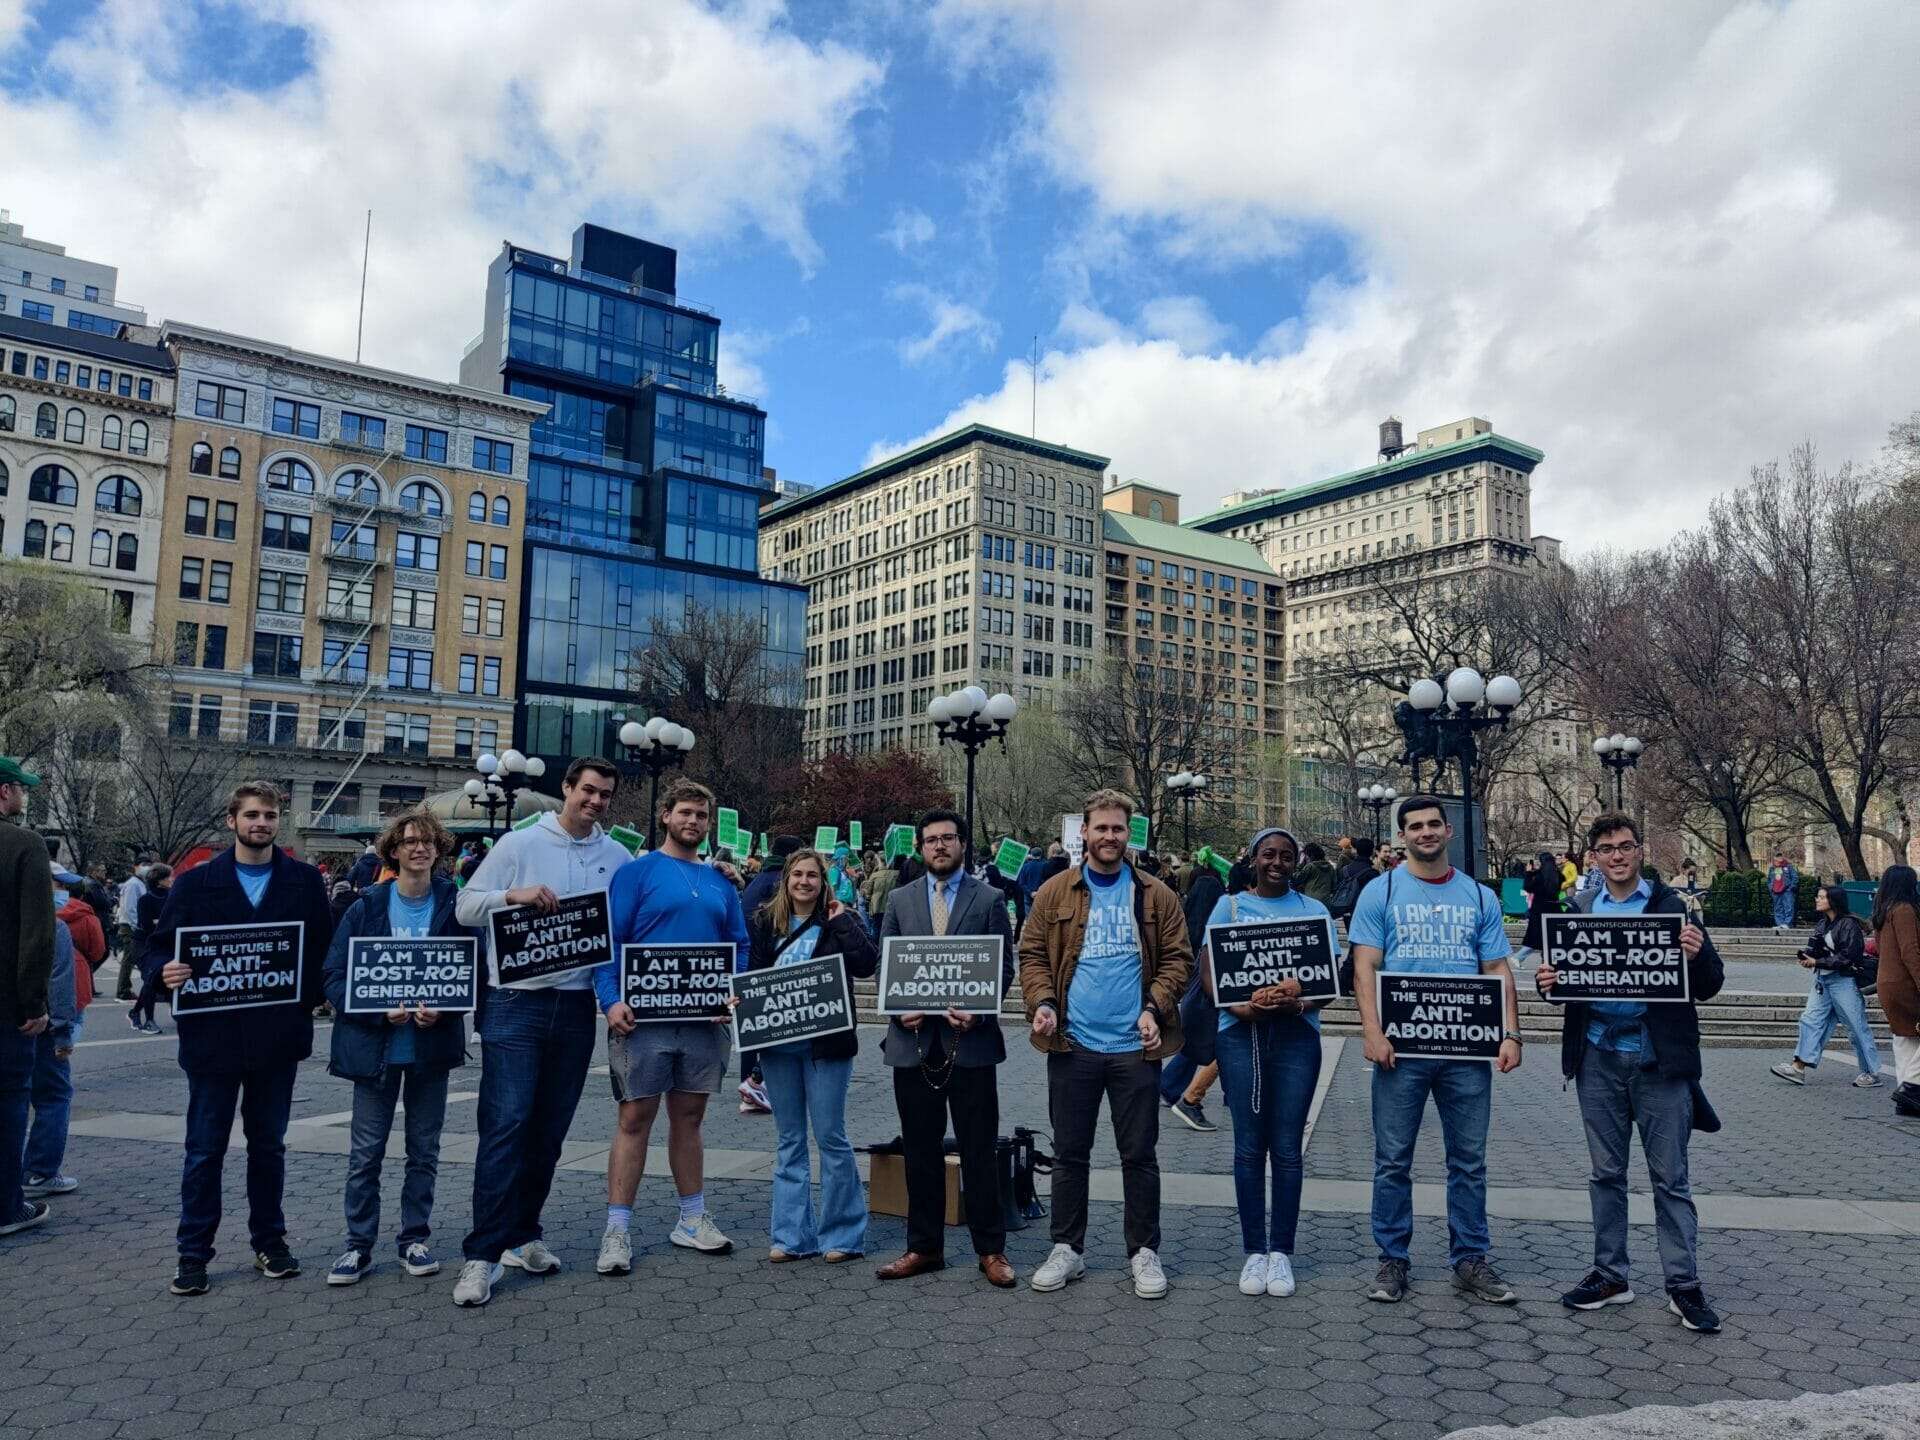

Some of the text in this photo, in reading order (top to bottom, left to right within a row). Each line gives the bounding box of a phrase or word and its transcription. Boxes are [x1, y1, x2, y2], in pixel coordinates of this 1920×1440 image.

[503, 907, 599, 935] THE FUTURE IS
[1393, 903, 1476, 927] I AM THE
[524, 924, 582, 948] ANTI-
[1237, 925, 1310, 937] STUDENTSFORLIFE.ORG
[1556, 930, 1672, 945] I AM THE
[190, 940, 290, 957] THE FUTURE IS
[1221, 934, 1319, 952] THE FUTURE IS
[361, 951, 465, 963] I AM THE
[500, 934, 607, 970] ABORTION
[897, 952, 990, 963] THE FUTURE IS
[1243, 949, 1301, 968] ANTI-
[1550, 948, 1681, 966] POST-ROE
[208, 955, 270, 974] ANTI-
[632, 957, 725, 971] I AM THE
[913, 965, 971, 980] ANTI-
[354, 965, 473, 981] POST-ROE
[626, 973, 731, 990] POST-ROE
[759, 965, 825, 982] STUDENTSFORLIFE.ORG
[1219, 964, 1331, 988] ABORTION
[1556, 970, 1679, 986] GENERATION
[180, 970, 295, 995] ABORTION
[355, 984, 469, 998] GENERATION
[742, 972, 834, 999] THE FUTURE IS
[887, 981, 995, 996] ABORTION
[1409, 981, 1484, 990] STUDENTSFORLIFE.ORG
[628, 992, 729, 1008] GENERATION
[762, 990, 818, 1012] ANTI-
[1391, 991, 1493, 1005] THE FUTURE IS
[740, 999, 844, 1033] ABORTION
[1410, 1005, 1473, 1022] ANTI-
[1384, 1022, 1500, 1042] ABORTION
